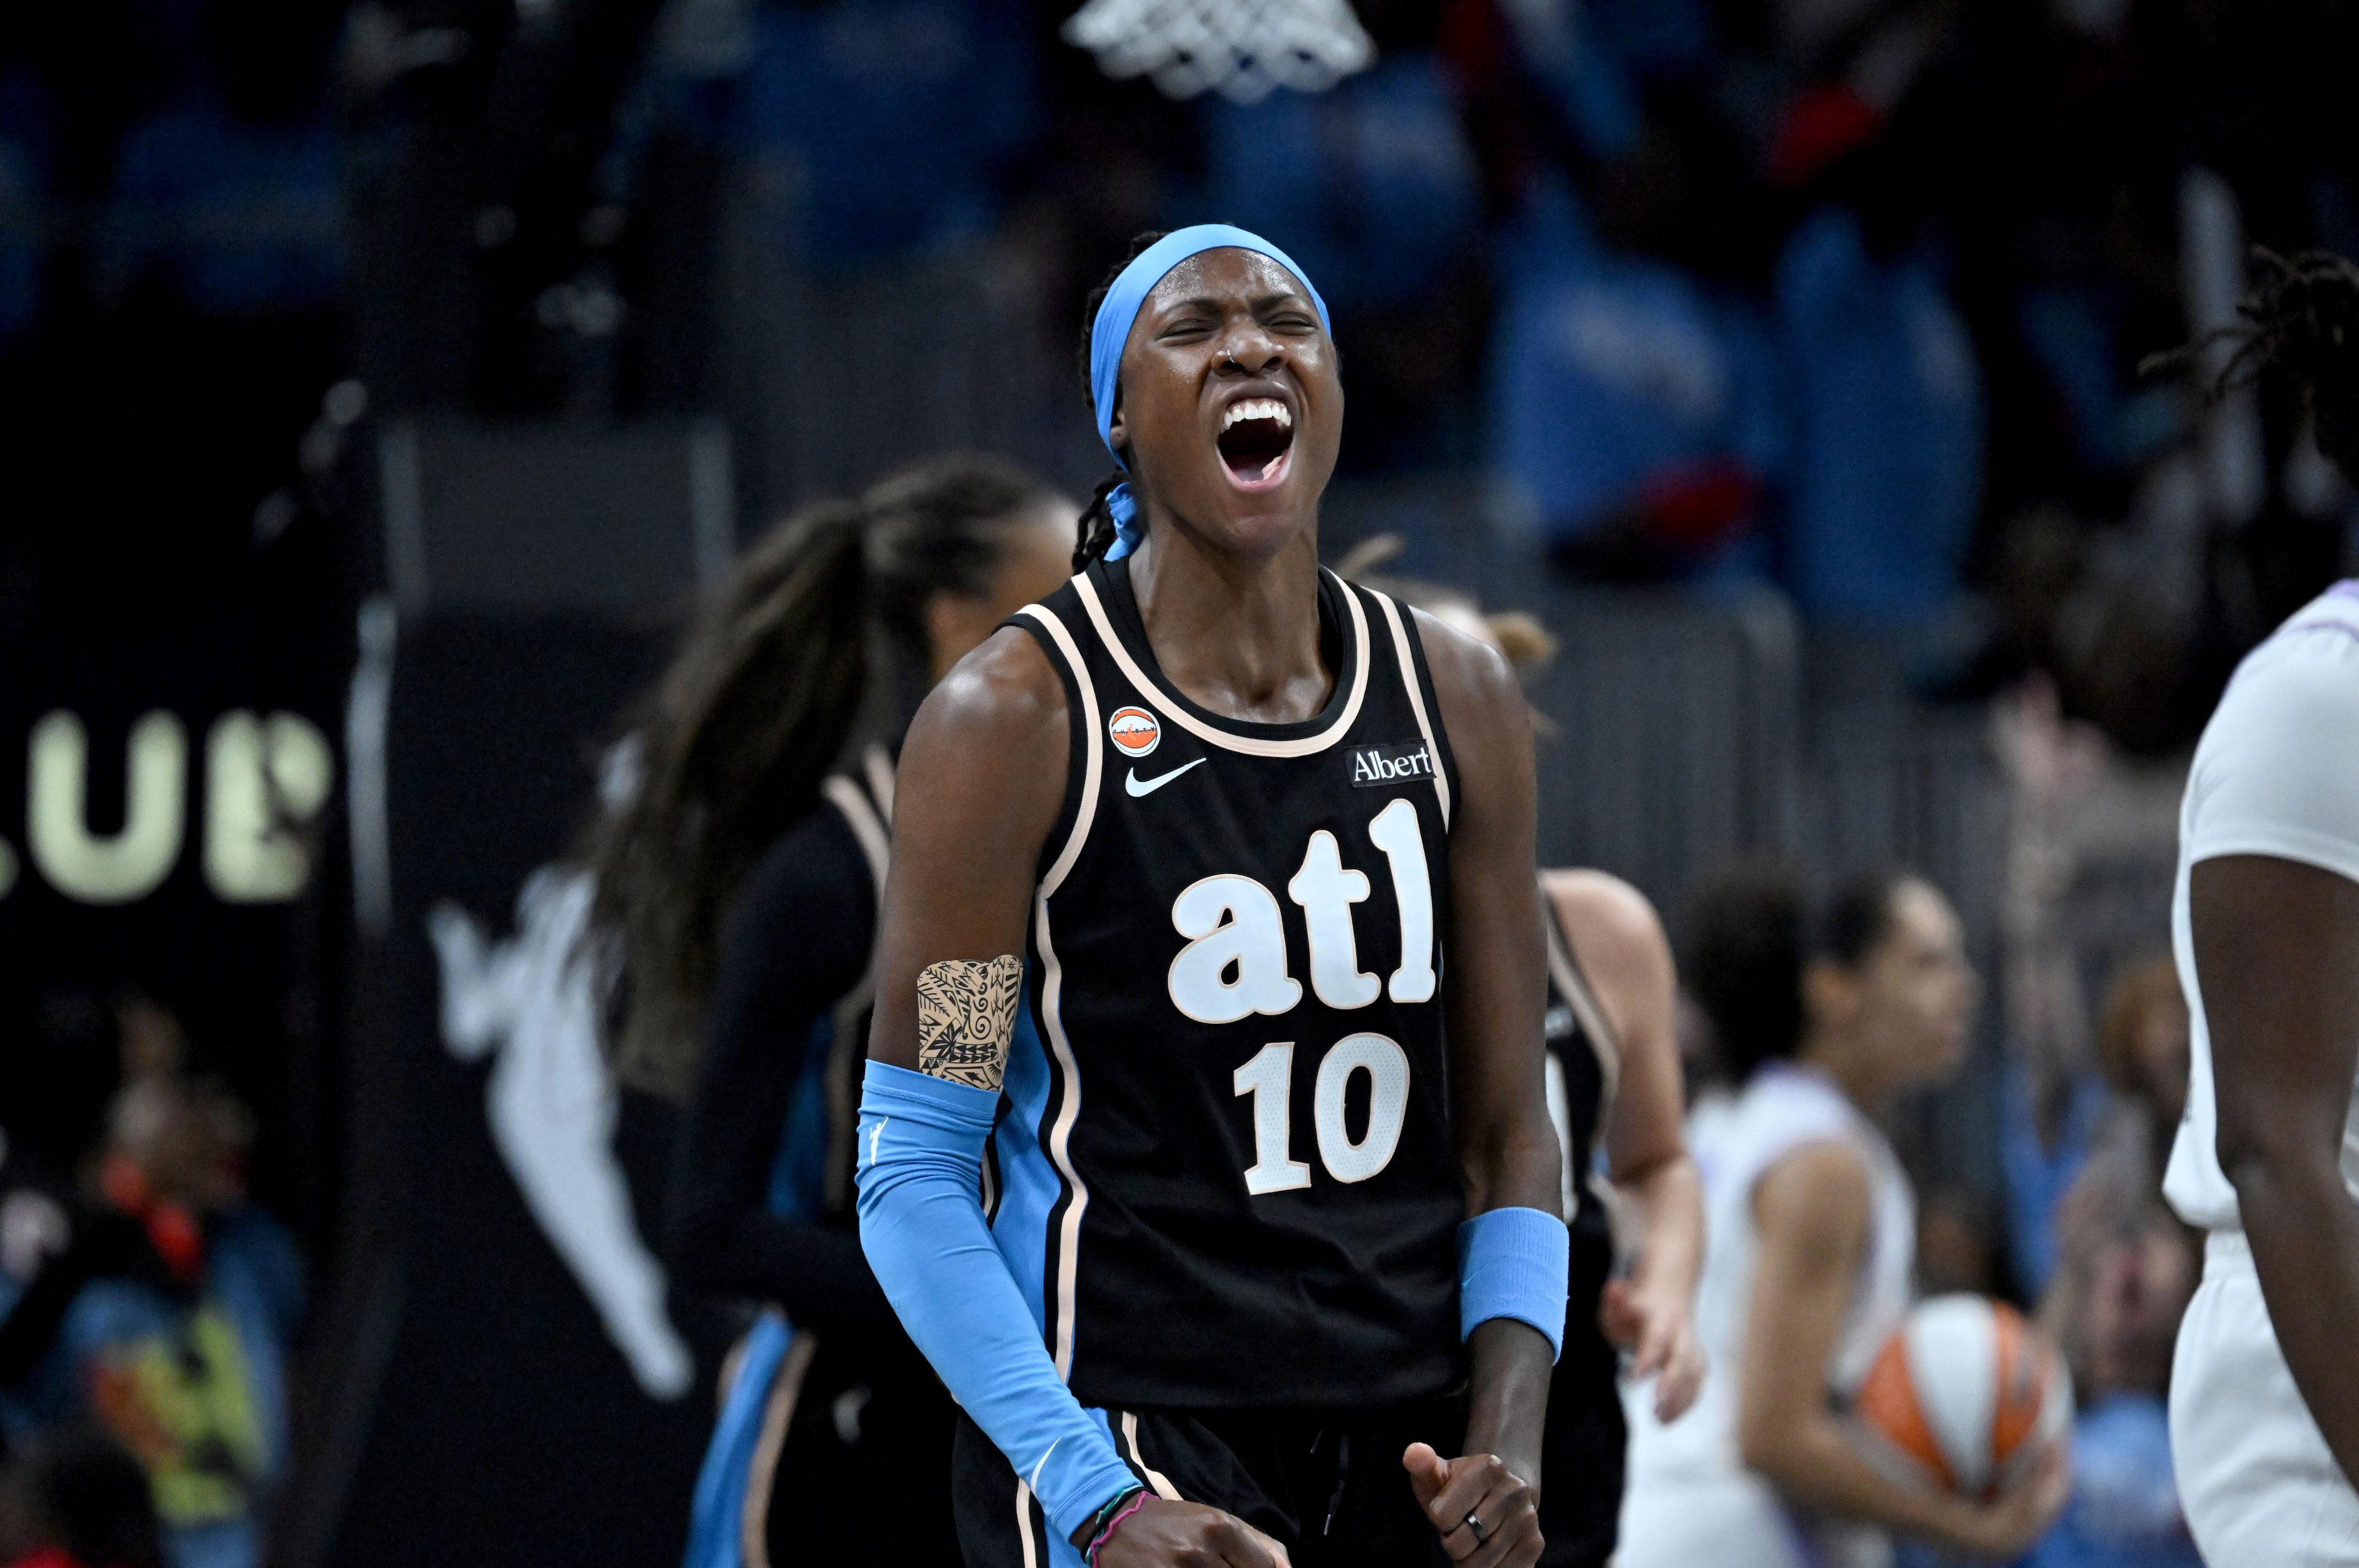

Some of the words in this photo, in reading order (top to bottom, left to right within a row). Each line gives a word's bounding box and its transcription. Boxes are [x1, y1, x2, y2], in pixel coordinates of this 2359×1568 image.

[0, 706, 335, 907] UB
[1354, 747, 1432, 781] Albert
[1168, 798, 1436, 1024] atl
[1234, 1032, 1410, 1195] 10
